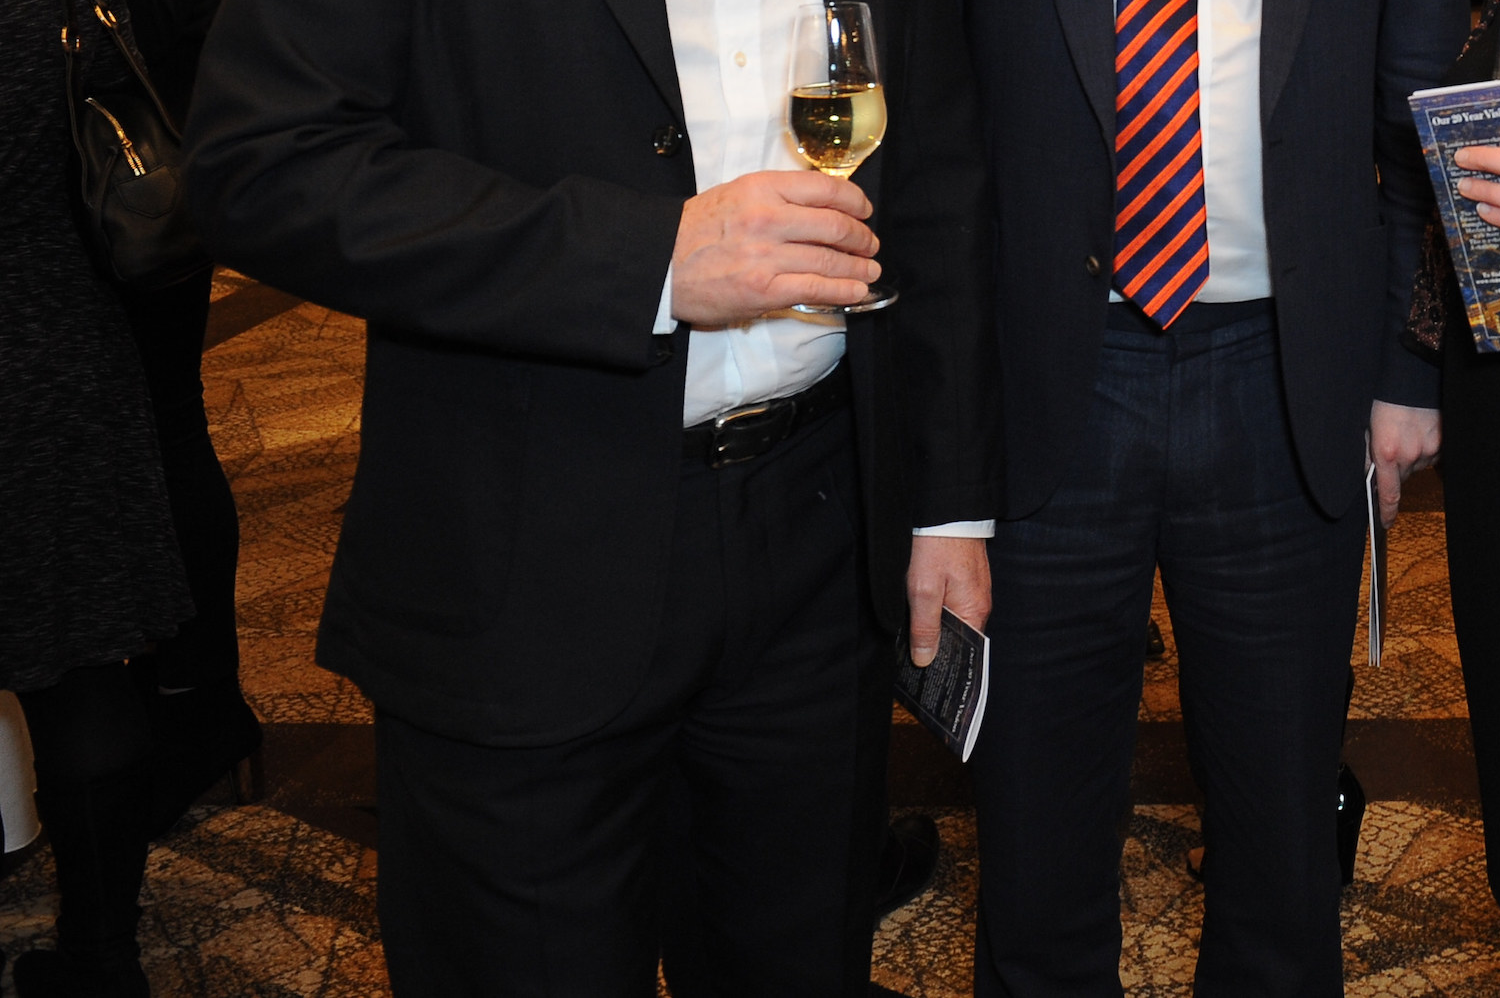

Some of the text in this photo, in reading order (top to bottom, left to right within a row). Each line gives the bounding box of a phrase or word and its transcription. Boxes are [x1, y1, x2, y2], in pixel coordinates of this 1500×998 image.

[1432, 116, 1451, 126] Our
[1450, 113, 1463, 124] 20
[1461, 112, 1485, 122] Year
